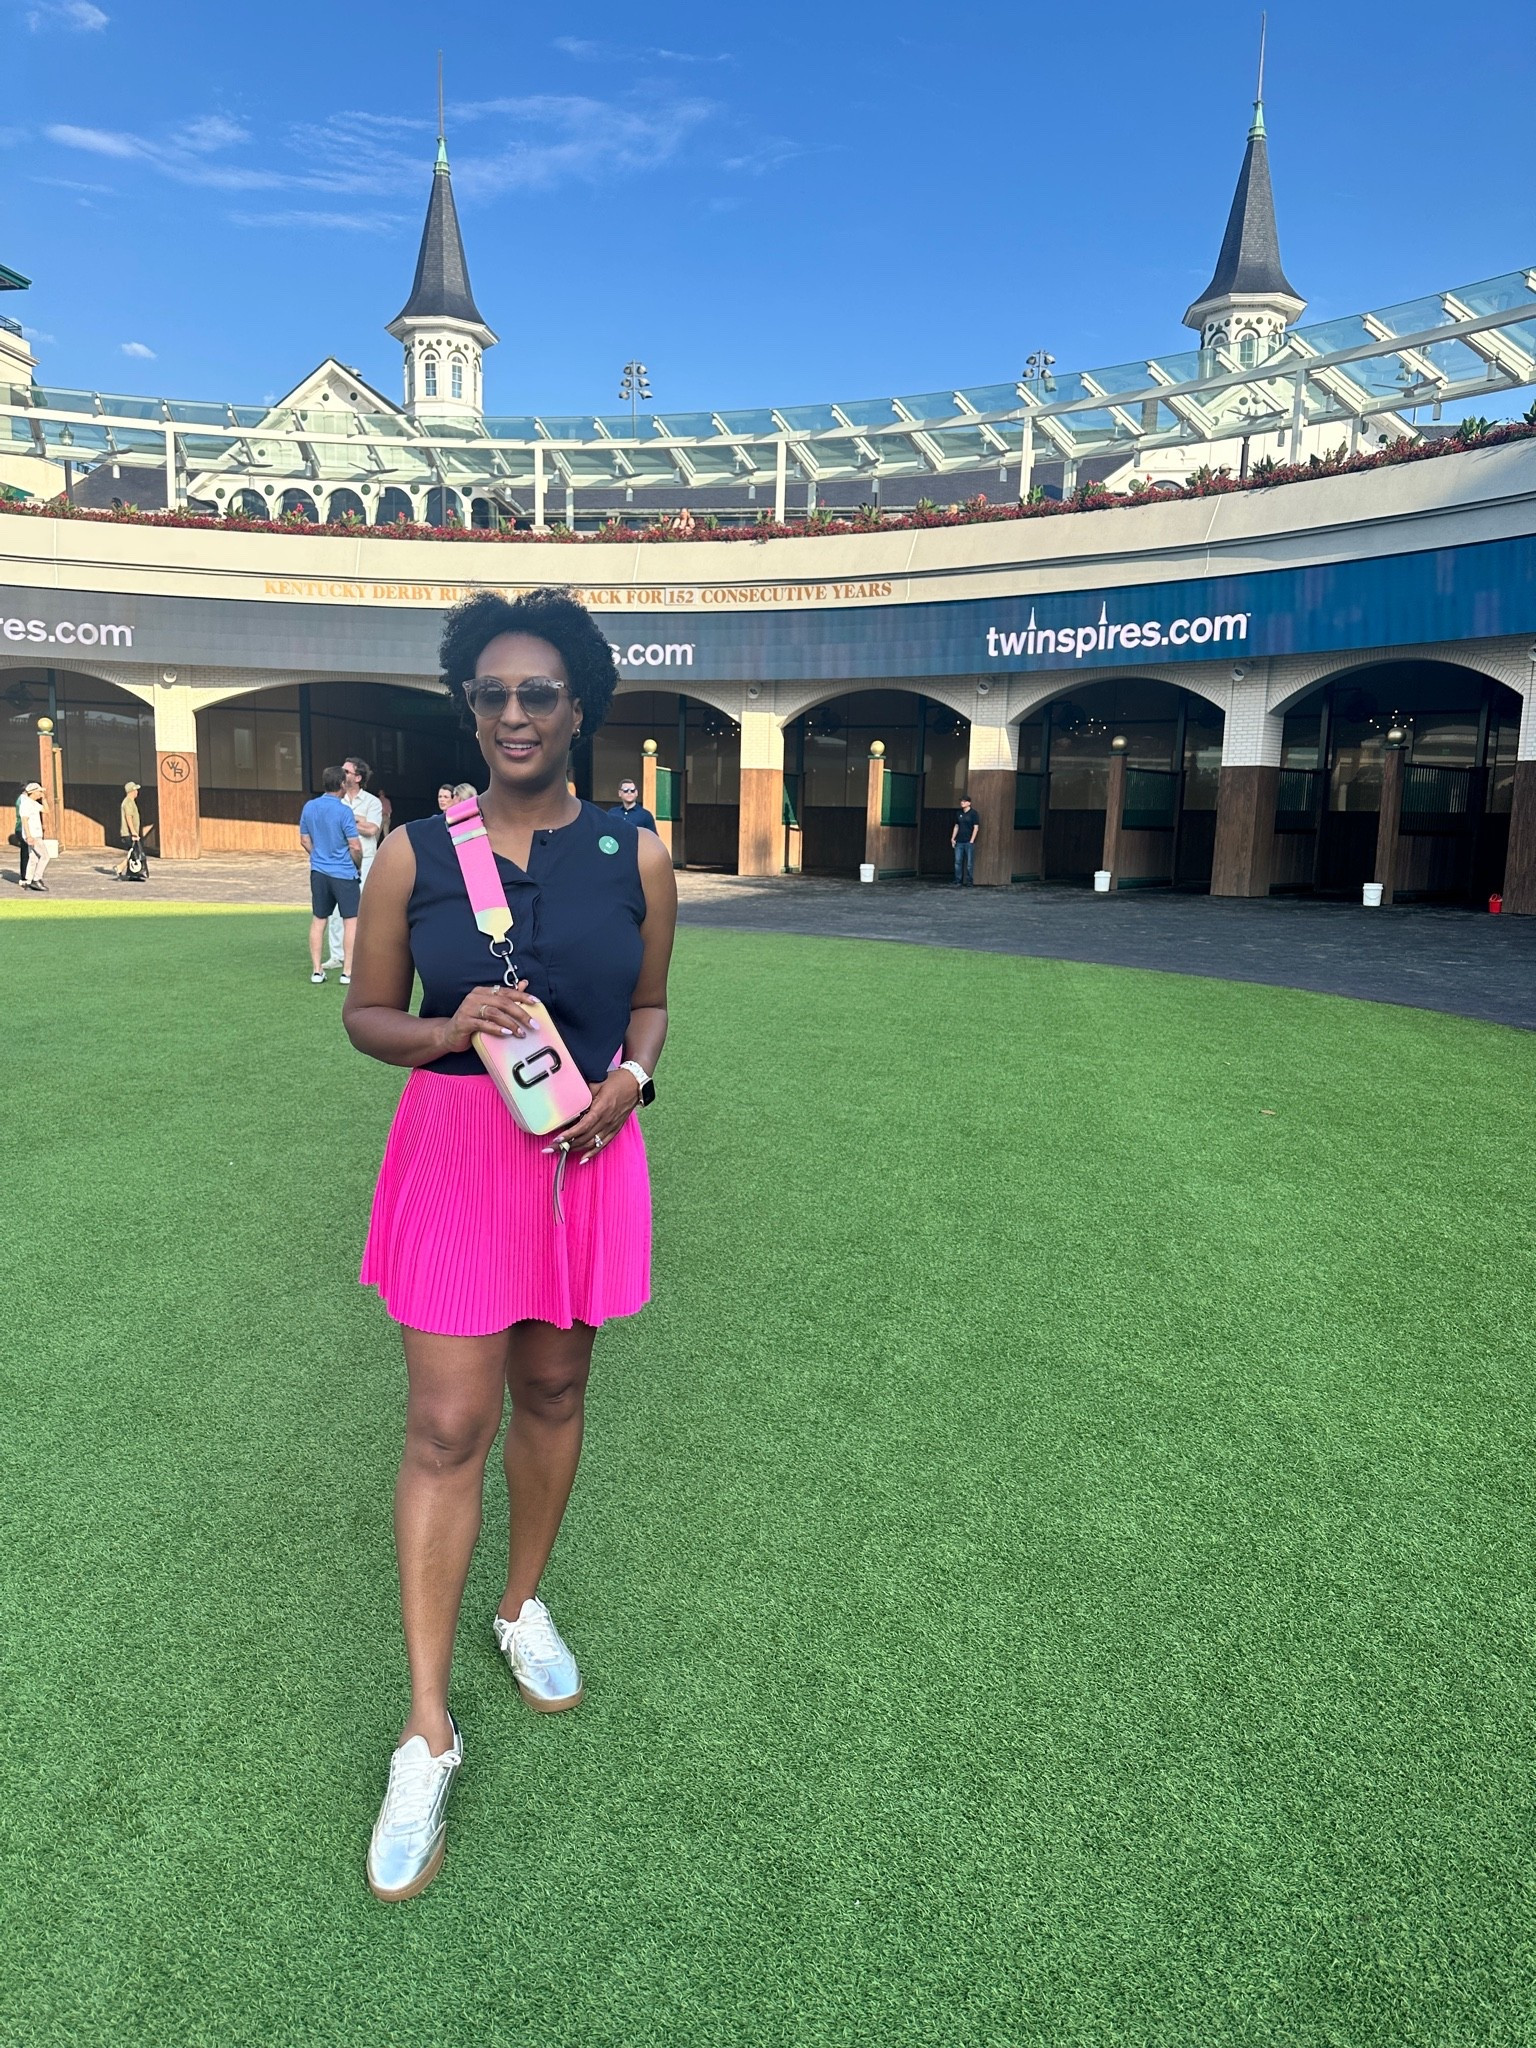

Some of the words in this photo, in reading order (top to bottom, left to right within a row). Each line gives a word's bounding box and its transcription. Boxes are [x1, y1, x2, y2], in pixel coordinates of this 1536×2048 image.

[264, 580, 368, 599] KENTUCKY
[372, 585, 436, 601] DERBY
[570, 589, 622, 605] RACK
[626, 589, 664, 604] FOR
[668, 590, 694, 604] 152
[701, 586, 828, 604] CONSECUTIVE
[832, 581, 893, 600] YEARS
[986, 601, 1249, 659] twinspires.com
